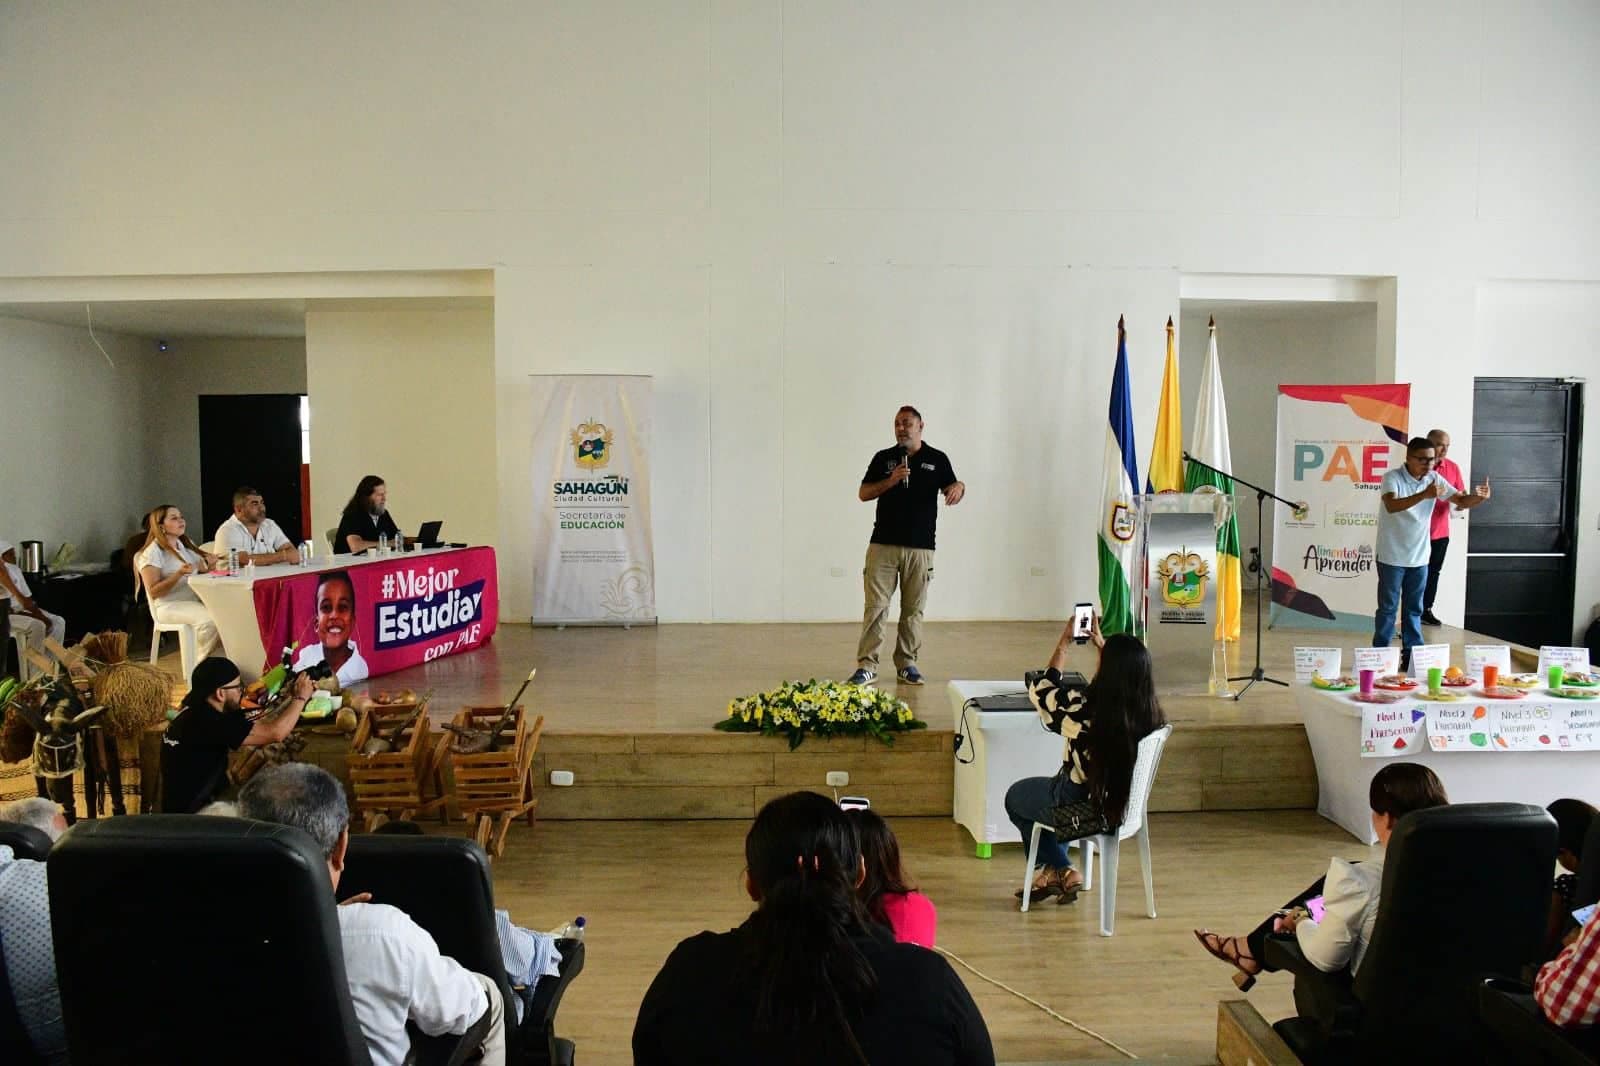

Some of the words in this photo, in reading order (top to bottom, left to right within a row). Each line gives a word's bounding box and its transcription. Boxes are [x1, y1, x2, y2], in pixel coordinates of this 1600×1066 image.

[1293, 444, 1390, 483] PAE
[553, 479, 628, 495] SAHAGÚN
[560, 520, 625, 529] EDUCACIÓN
[1334, 518, 1378, 526] EDUCACI
[1303, 544, 1374, 572] Aprender
[381, 566, 459, 602] #Mejor
[423, 640, 454, 661] con
